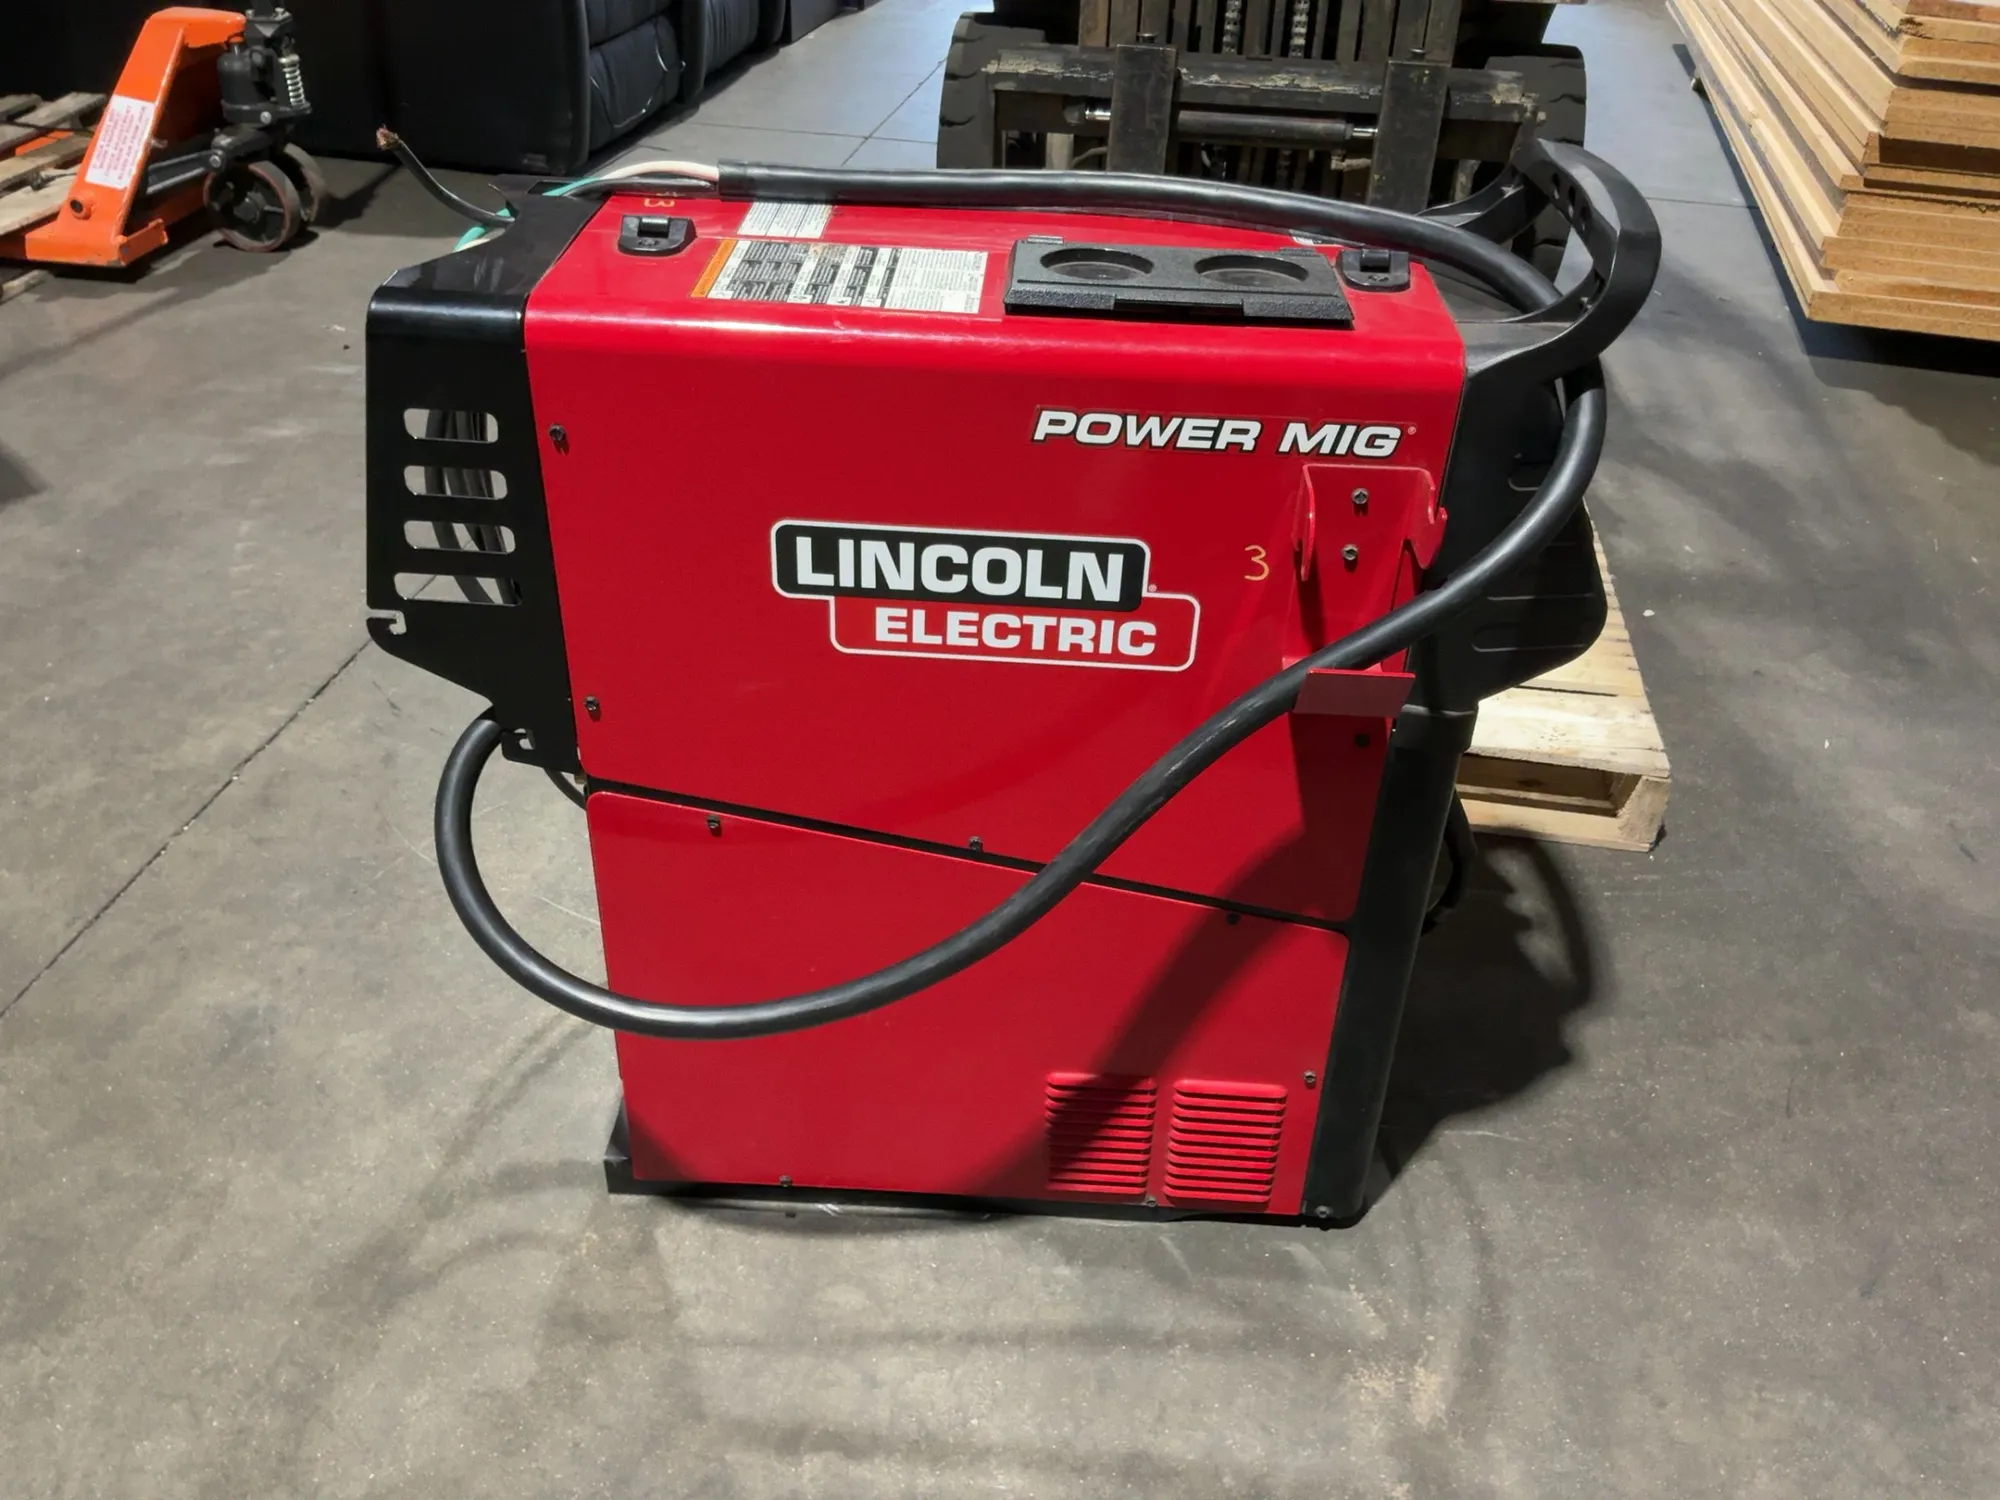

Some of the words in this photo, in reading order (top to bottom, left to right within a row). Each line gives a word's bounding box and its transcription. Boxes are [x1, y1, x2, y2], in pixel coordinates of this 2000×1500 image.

[1032, 410, 1262, 451] POWER
[1277, 422, 1403, 457] MIG
[795, 536, 1124, 603] LINCOLN
[1244, 544, 1270, 582] 3
[874, 606, 1158, 657] ELECTRIC
